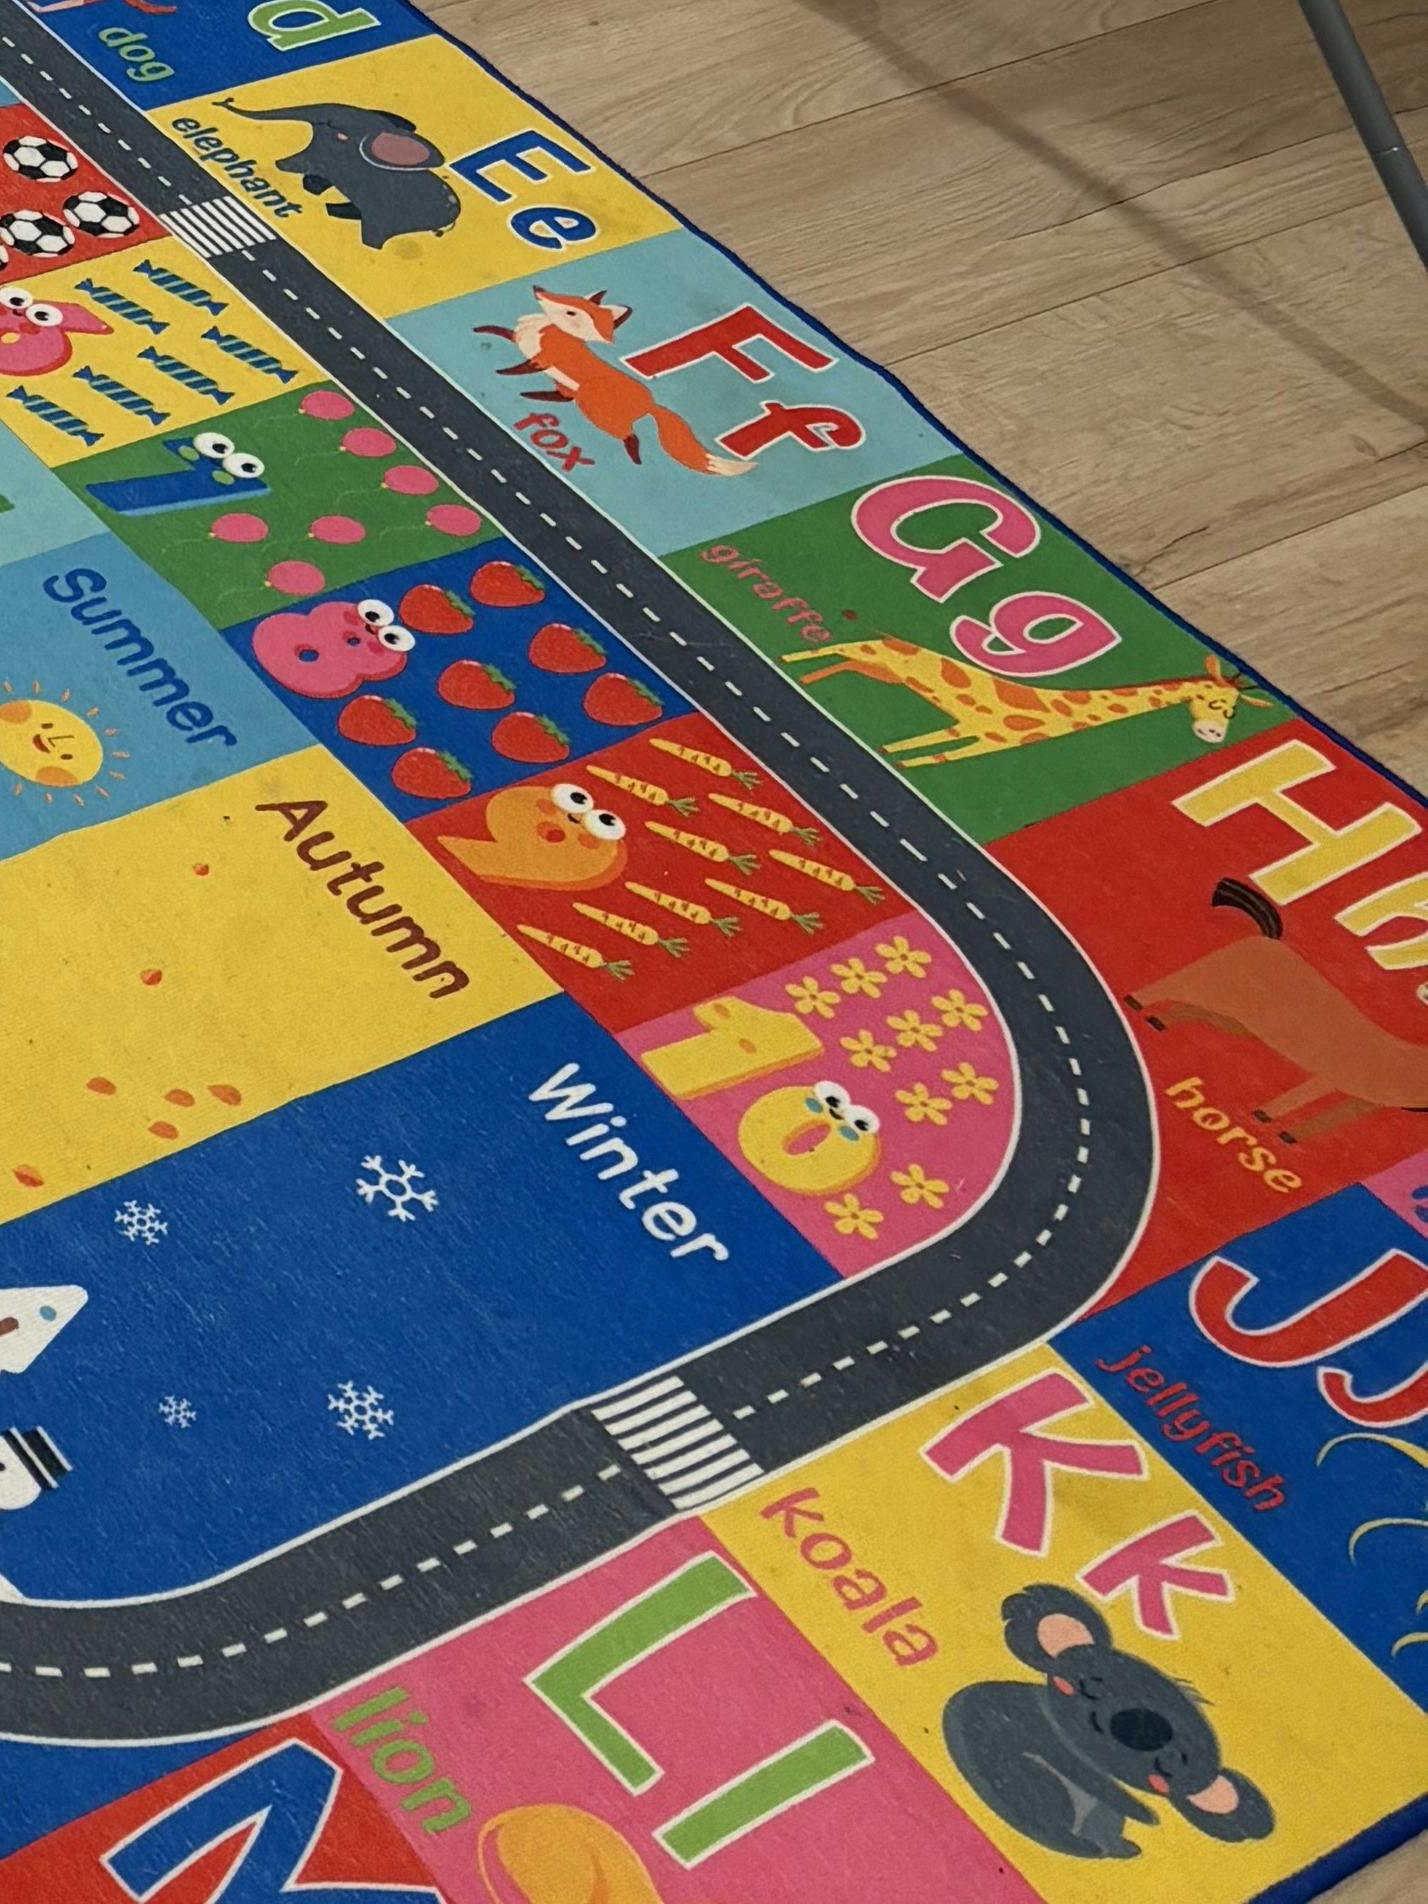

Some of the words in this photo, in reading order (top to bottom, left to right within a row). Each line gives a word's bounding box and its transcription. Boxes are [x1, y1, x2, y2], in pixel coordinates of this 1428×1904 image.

[97, 24, 177, 84] dog
[171, 114, 303, 221] elephant
[513, 410, 596, 473] fox
[42, 566, 236, 751] Summer
[699, 539, 834, 648] giraffe
[255, 796, 471, 1000] Autumn
[528, 1062, 729, 1266] Winter
[1164, 1077, 1303, 1195] horse
[1096, 1343, 1290, 1514] jellyfish
[758, 1484, 944, 1670] koala
[334, 1687, 479, 1840] lion
